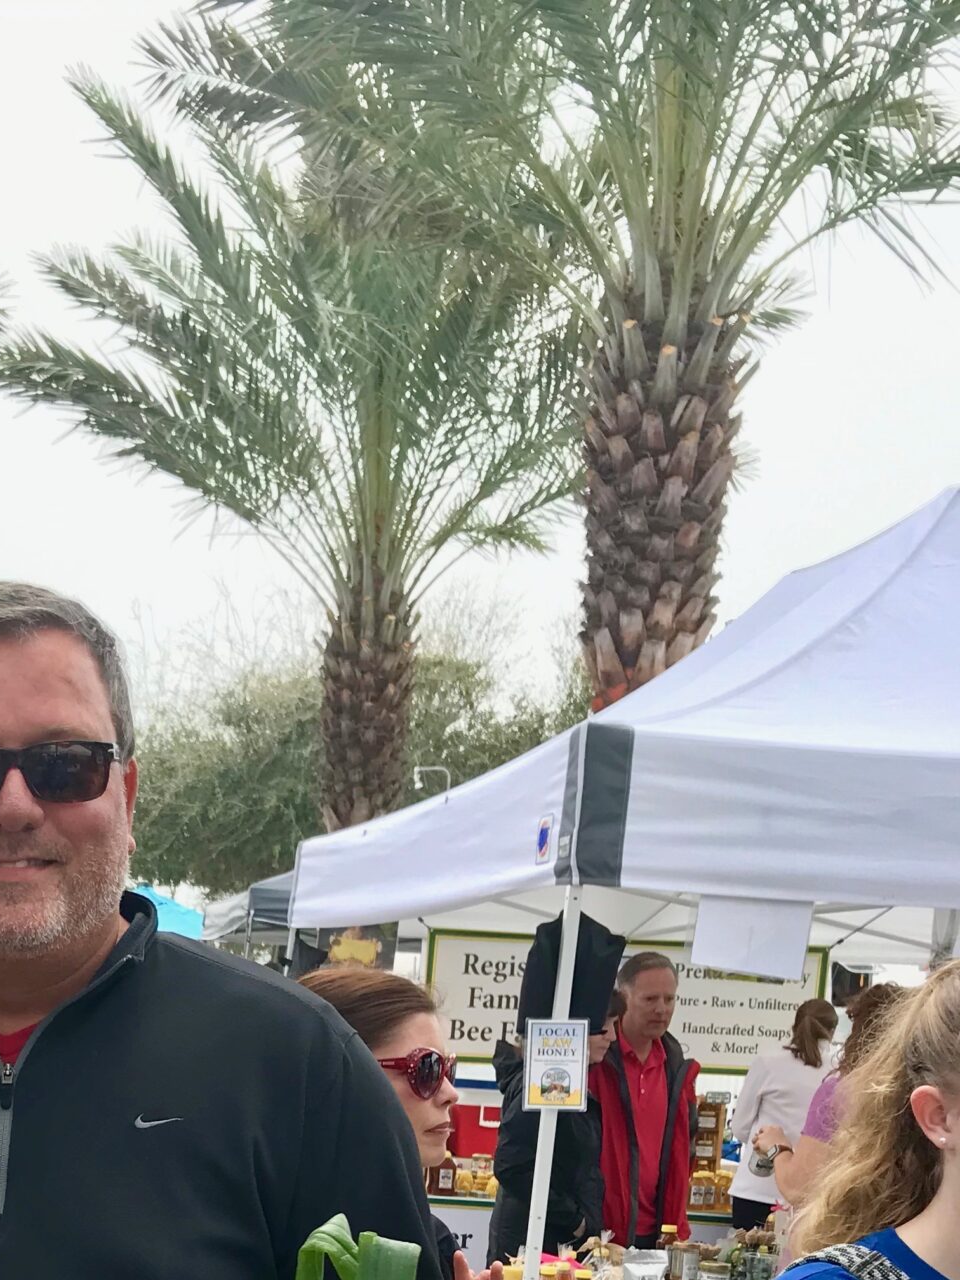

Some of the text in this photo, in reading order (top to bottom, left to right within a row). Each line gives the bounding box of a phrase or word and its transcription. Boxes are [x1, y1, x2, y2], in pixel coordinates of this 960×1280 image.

[462, 953, 527, 983] Regis
[467, 986, 519, 1010] Fam
[711, 996, 737, 1008] Raw
[748, 998, 800, 1012] Unfiltere
[448, 1019, 493, 1042] Bee
[538, 1028, 578, 1037] LOCAL
[682, 1022, 791, 1041] Handcrafted Soaps
[542, 1037, 573, 1048] RAW
[711, 1041, 758, 1054] & More!
[537, 1048, 577, 1057] HONEY
